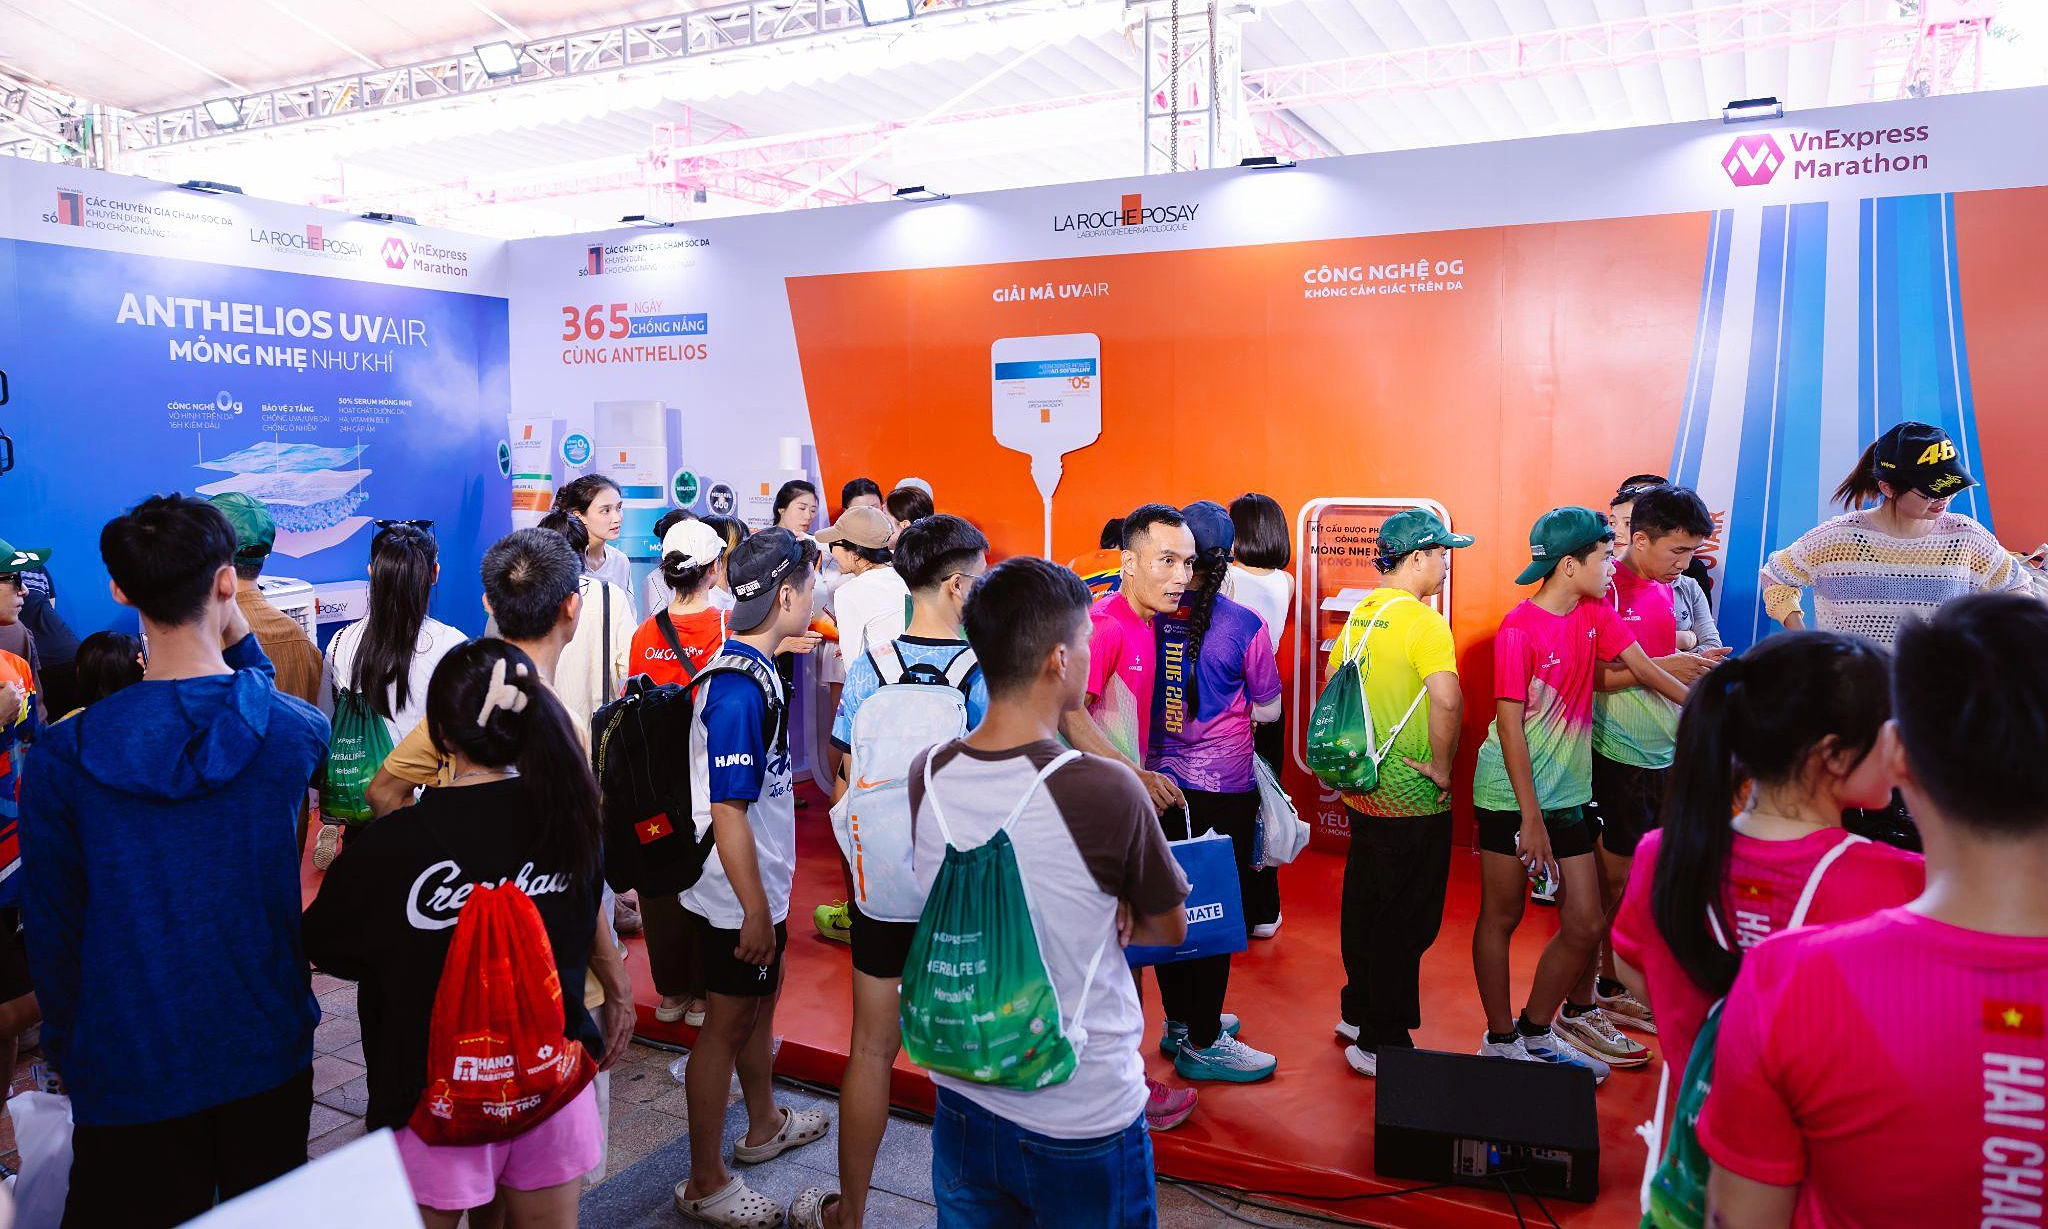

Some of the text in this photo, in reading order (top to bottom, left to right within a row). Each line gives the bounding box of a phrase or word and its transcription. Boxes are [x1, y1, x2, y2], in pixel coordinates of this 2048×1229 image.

[1790, 125, 1929, 152] VnExpress
[1794, 152, 1928, 180] Marathon
[1054, 203, 1200, 232] LA ROCHE POSAY
[250, 228, 269, 243] LA
[271, 231, 319, 250] ROCHE
[322, 239, 363, 256] POSAY
[411, 241, 467, 261] VnExpress
[413, 259, 468, 277] Marathon
[1303, 264, 1363, 284] CÔNG
[1369, 258, 1430, 281] NGHỆ
[992, 282, 1110, 302] GIẢI MÃ UVAIR
[1304, 286, 1348, 299] KHÔNG
[1379, 282, 1407, 295] GIÁC
[1409, 281, 1443, 293] TRÊN
[1446, 280, 1463, 291] DA
[634, 298, 663, 314] NGÀY
[116, 292, 428, 347] ANTHELIOS UVAIR
[562, 303, 630, 341] 365
[631, 317, 671, 334] CHỐNG
[169, 334, 393, 373] MỎNG NHẸ NHƯ KHÍ
[562, 343, 708, 365] CÙNG ANTHELIOS
[1917, 439, 1956, 465] 46
[1326, 523, 1342, 533] CẤU
[1344, 525, 1367, 534] ĐƯỢC
[1335, 535, 1358, 543] CÔNG
[320, 602, 348, 614] POSAY
[1165, 685, 1184, 735] 2026
[1736, 910, 1771, 953] HA
[478, 1055, 514, 1070] HANO
